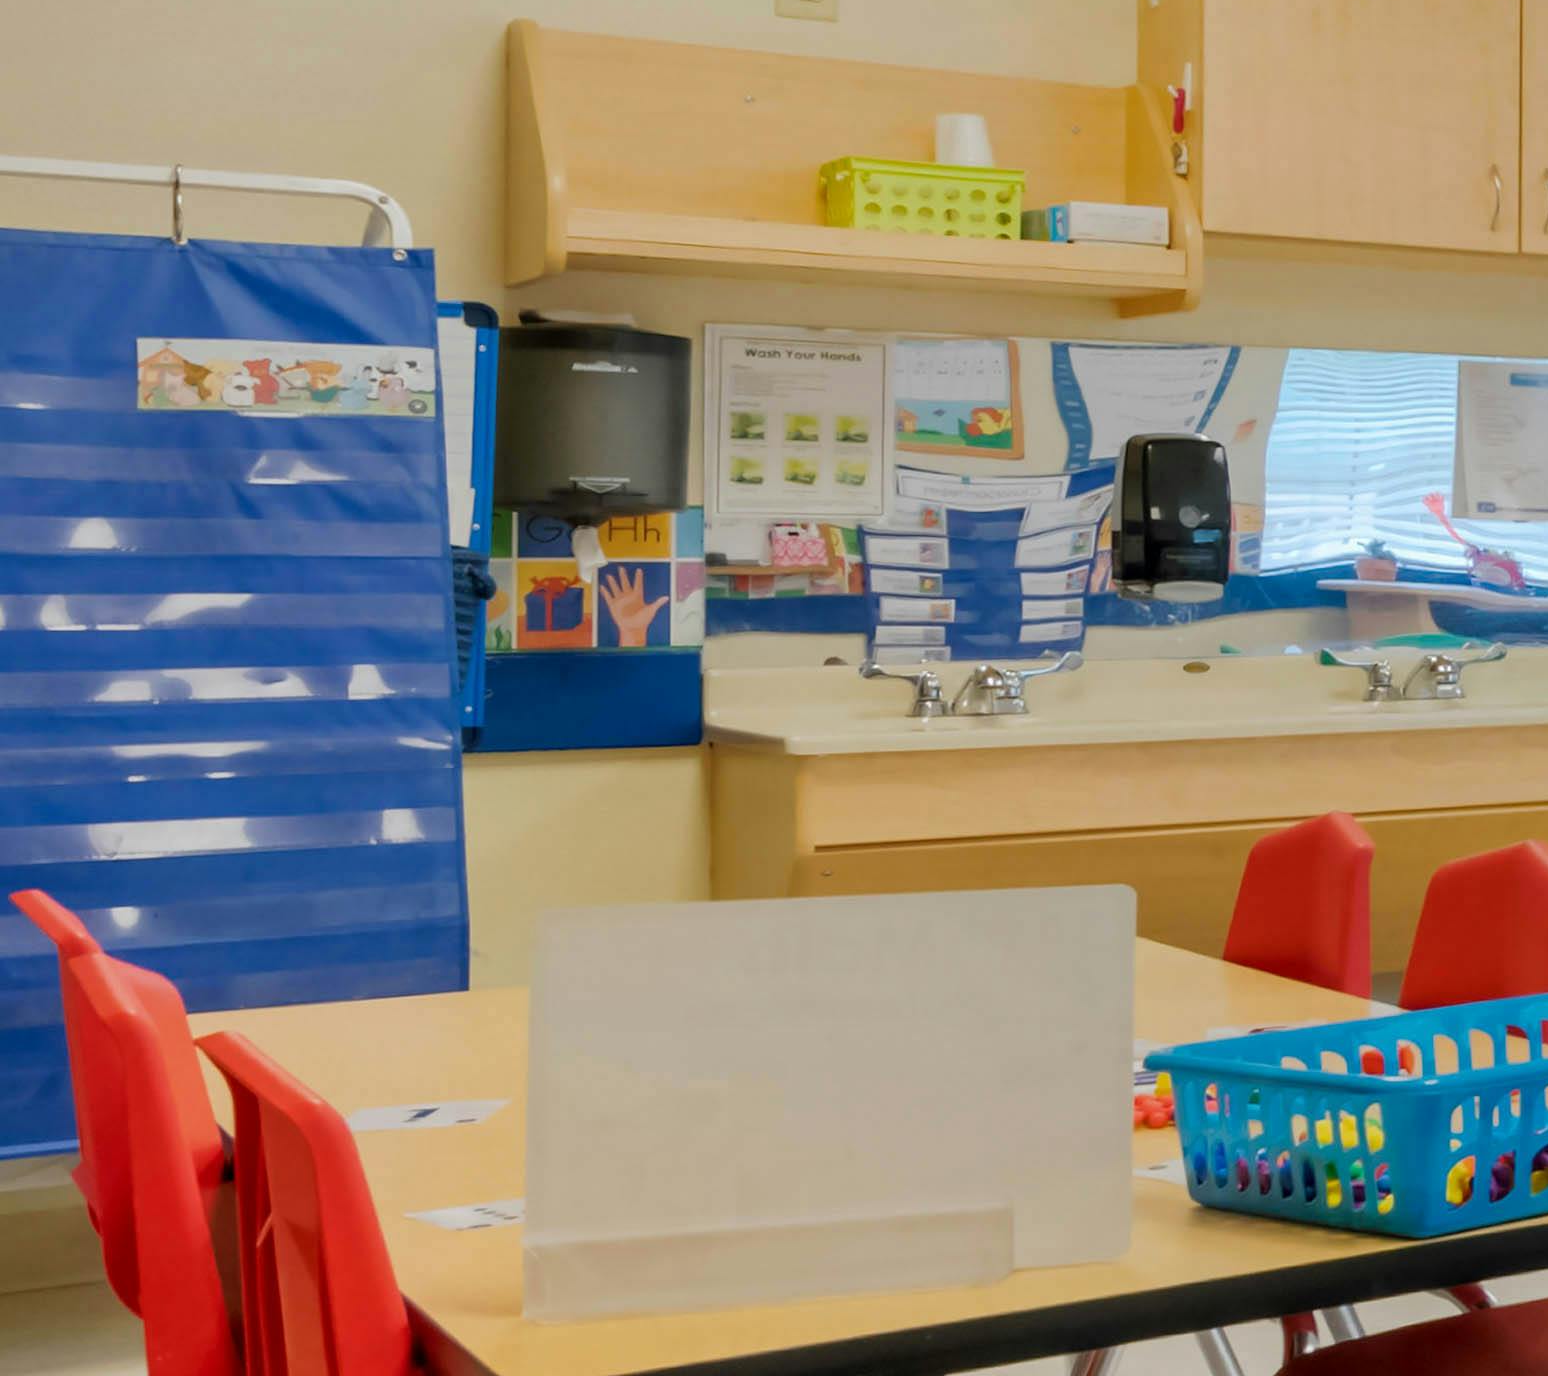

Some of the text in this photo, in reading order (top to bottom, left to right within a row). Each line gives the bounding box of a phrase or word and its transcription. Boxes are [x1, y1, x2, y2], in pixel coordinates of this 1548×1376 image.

[744, 348, 862, 362] Wash Your Hands
[608, 514, 661, 543] Hh
